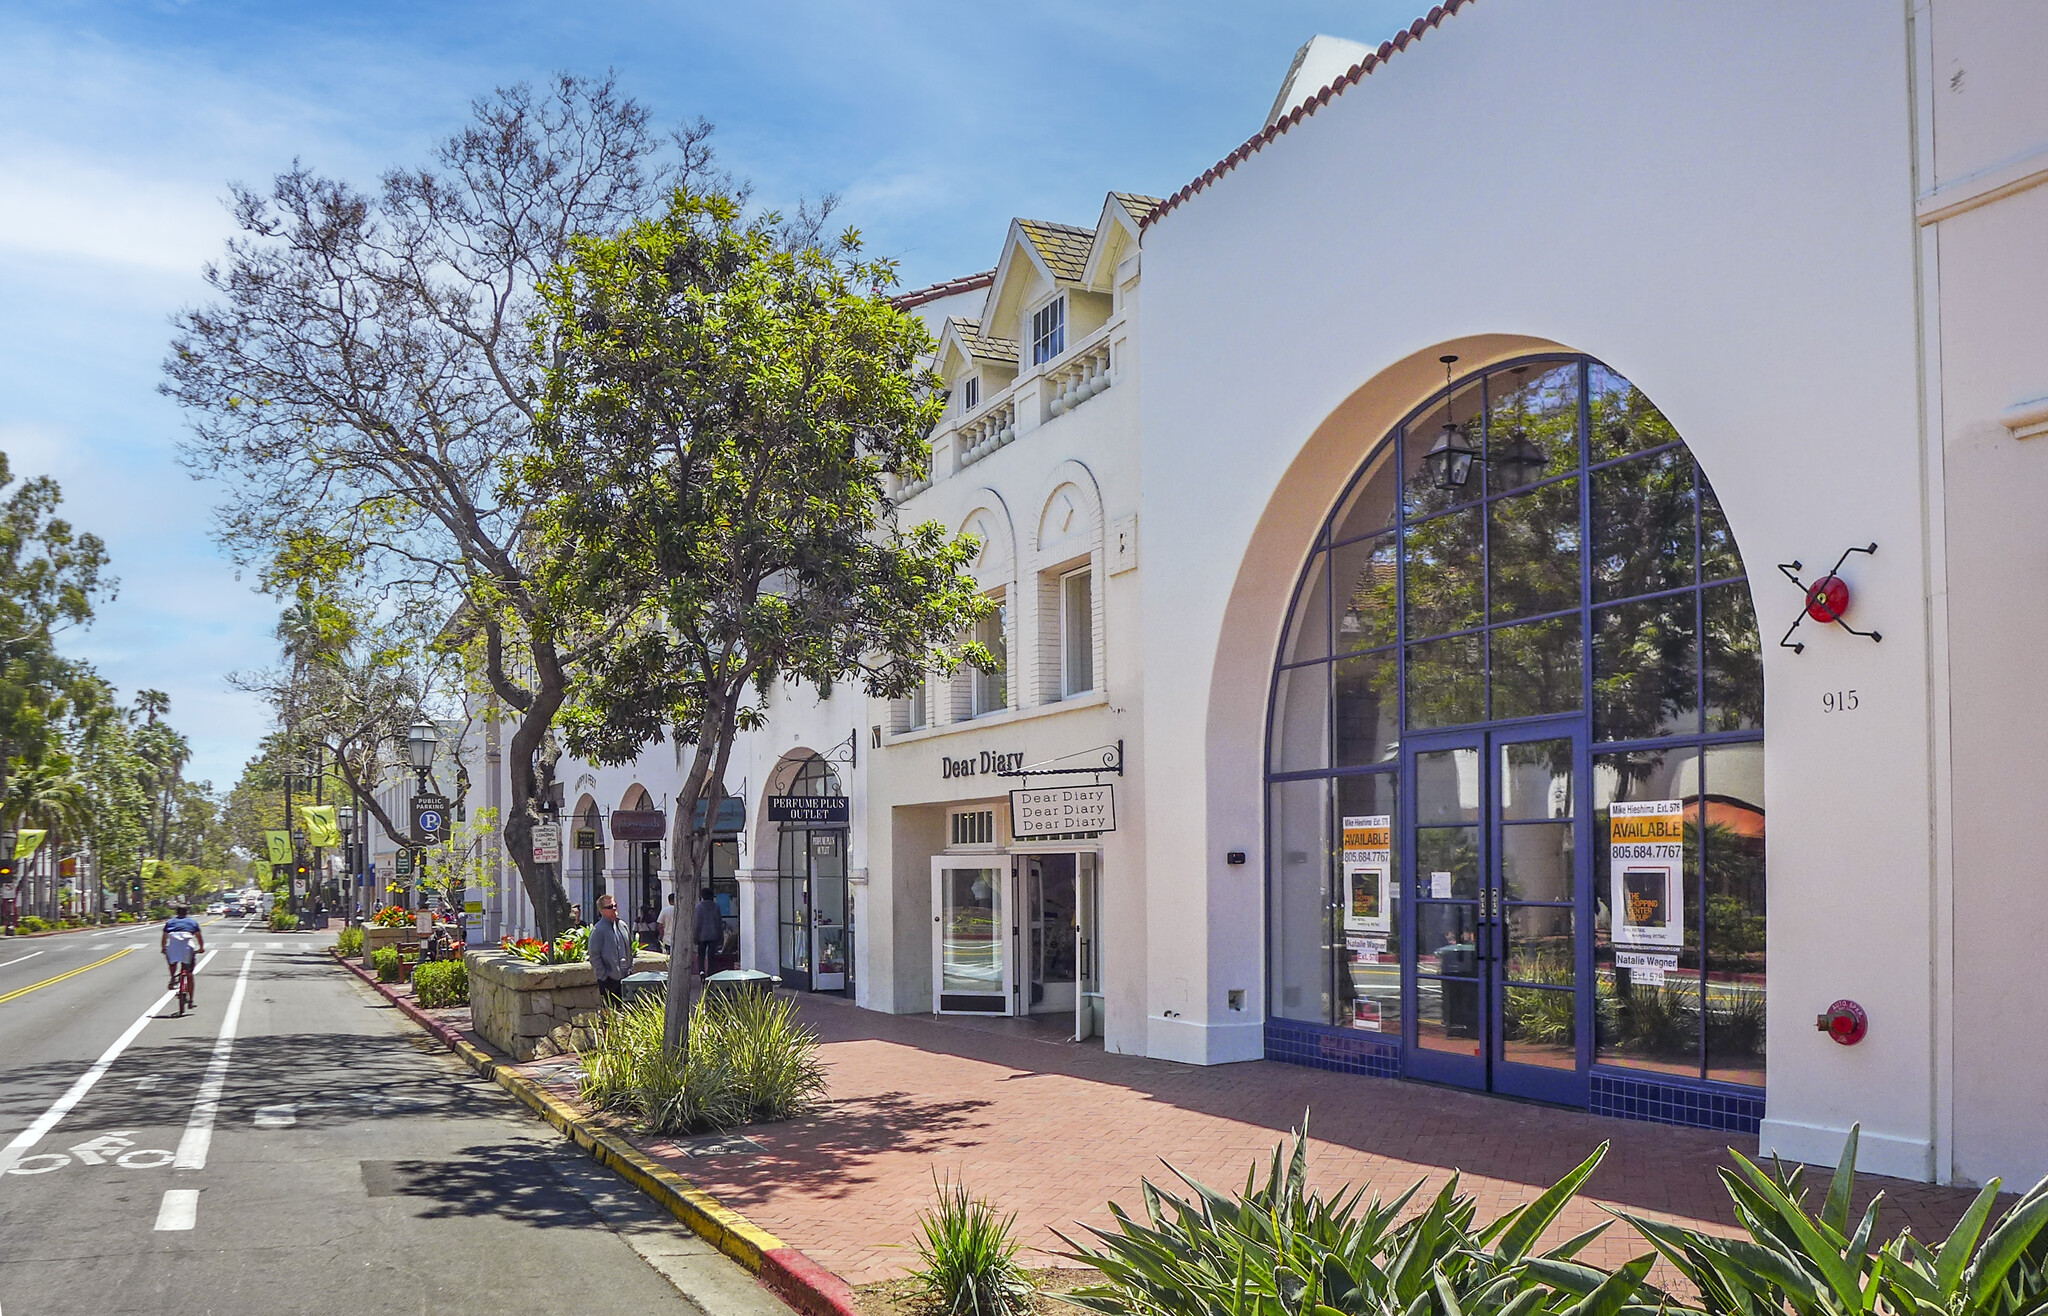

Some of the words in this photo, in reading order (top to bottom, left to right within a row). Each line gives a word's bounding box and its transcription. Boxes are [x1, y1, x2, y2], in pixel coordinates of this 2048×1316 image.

[1823, 690, 1859, 713] 915
[942, 757, 977, 779] Dear
[980, 751, 1024, 774] Diary
[773, 798, 819, 809] PERFUME
[820, 798, 845, 809] PLUS
[1021, 793, 1058, 804] Dear
[1062, 790, 1104, 802] Diary
[790, 809, 829, 819] OUTLET
[1022, 806, 1059, 818] Dear
[1063, 804, 1105, 816] Diary
[1612, 805, 1626, 815] Mike
[1023, 820, 1060, 831] Dear
[1064, 817, 1106, 829] Diary
[1612, 822, 1681, 838] AVAILABLE
[1344, 832, 1389, 846] AVAILABLE
[1344, 851, 1389, 863] 805.684.7767
[1612, 845, 1682, 859] 805.684.7767
[1628, 892, 1640, 900] THE
[1628, 899, 1659, 908] SHOPPING
[1347, 940, 1366, 949] Natalie
[1366, 940, 1386, 951] Wagner
[1617, 954, 1645, 966] Natalie
[1646, 956, 1677, 969] Wagner
